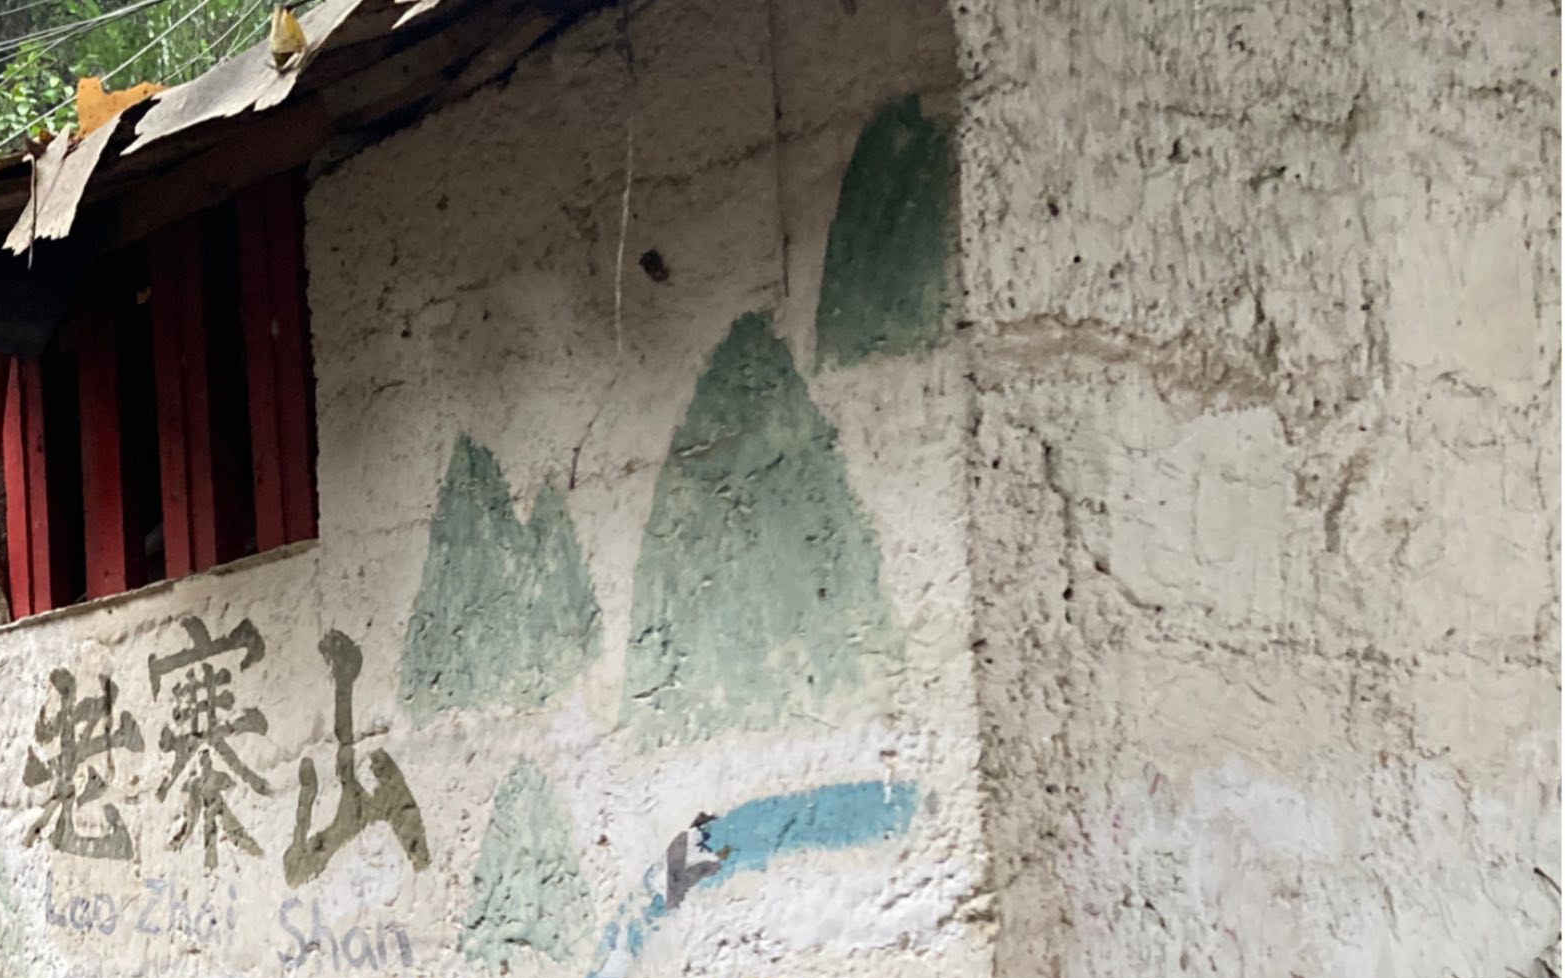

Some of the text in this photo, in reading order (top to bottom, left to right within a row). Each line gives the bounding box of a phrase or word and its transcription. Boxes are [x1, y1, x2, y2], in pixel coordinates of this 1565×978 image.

[22, 615, 431, 888] 老寨山
[135, 876, 238, 943] Zhai
[277, 894, 414, 972] Shan
